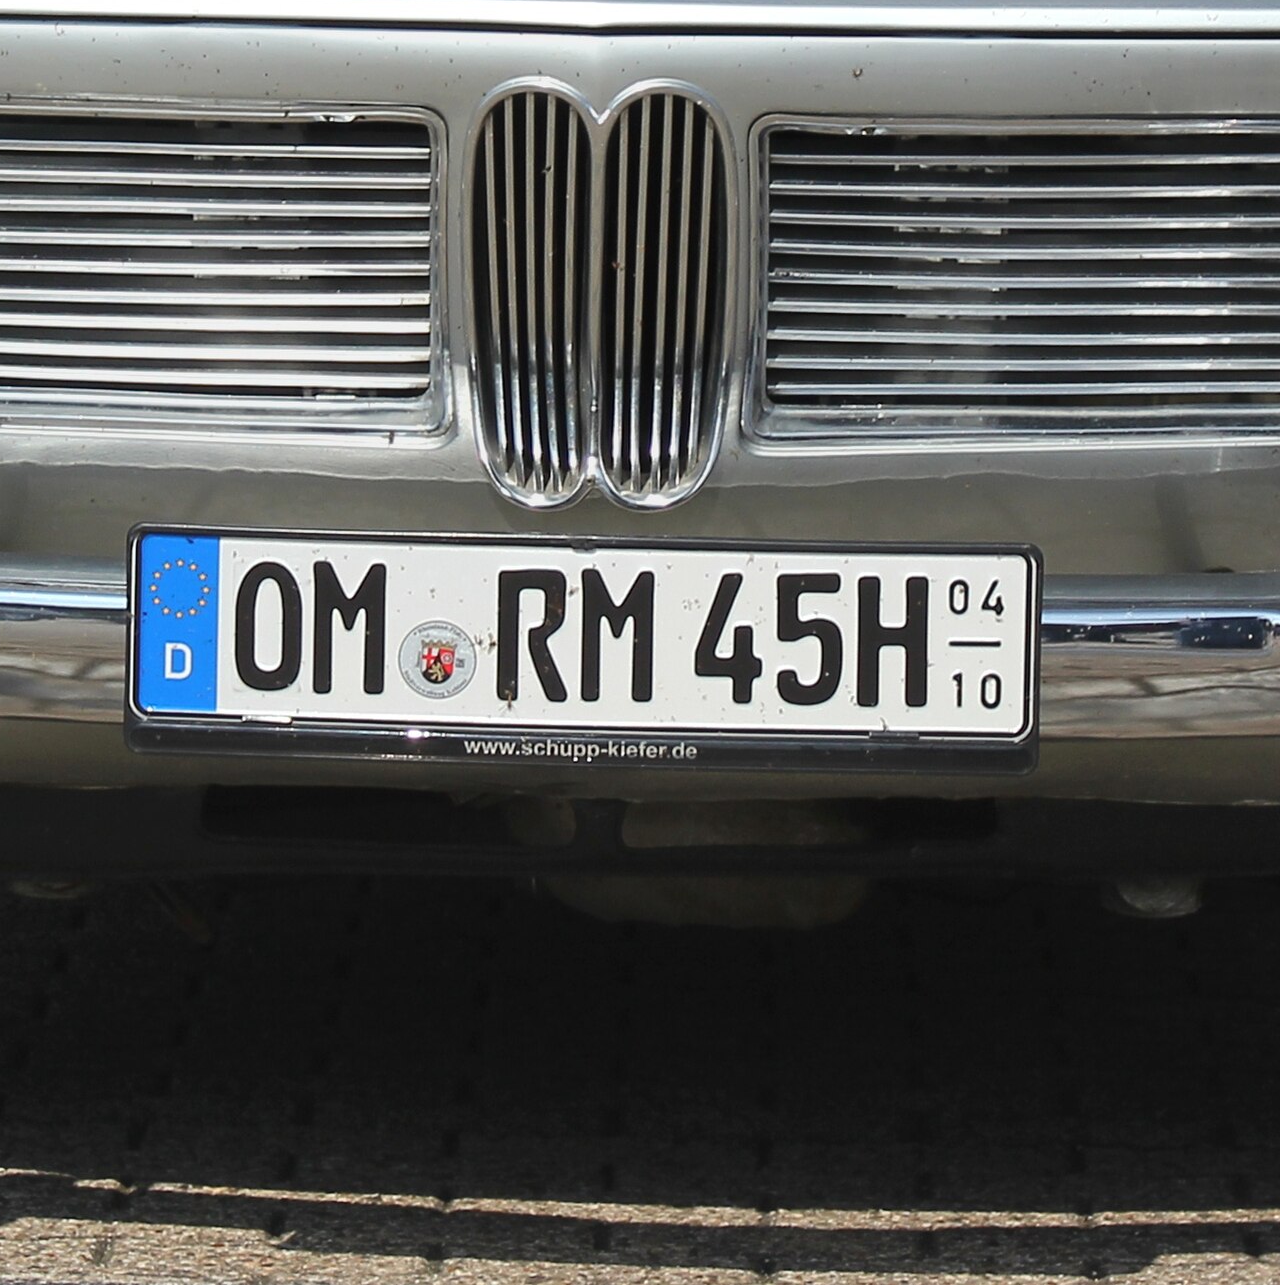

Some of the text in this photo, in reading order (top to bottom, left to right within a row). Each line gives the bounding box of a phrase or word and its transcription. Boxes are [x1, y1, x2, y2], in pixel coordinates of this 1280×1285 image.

[949, 579, 1005, 616] 04
[234, 560, 929, 708] OM RM 45H
[164, 642, 192, 680] D
[952, 671, 1002, 709] 10
[463, 737, 698, 760] www.schupp-kiefer.de
